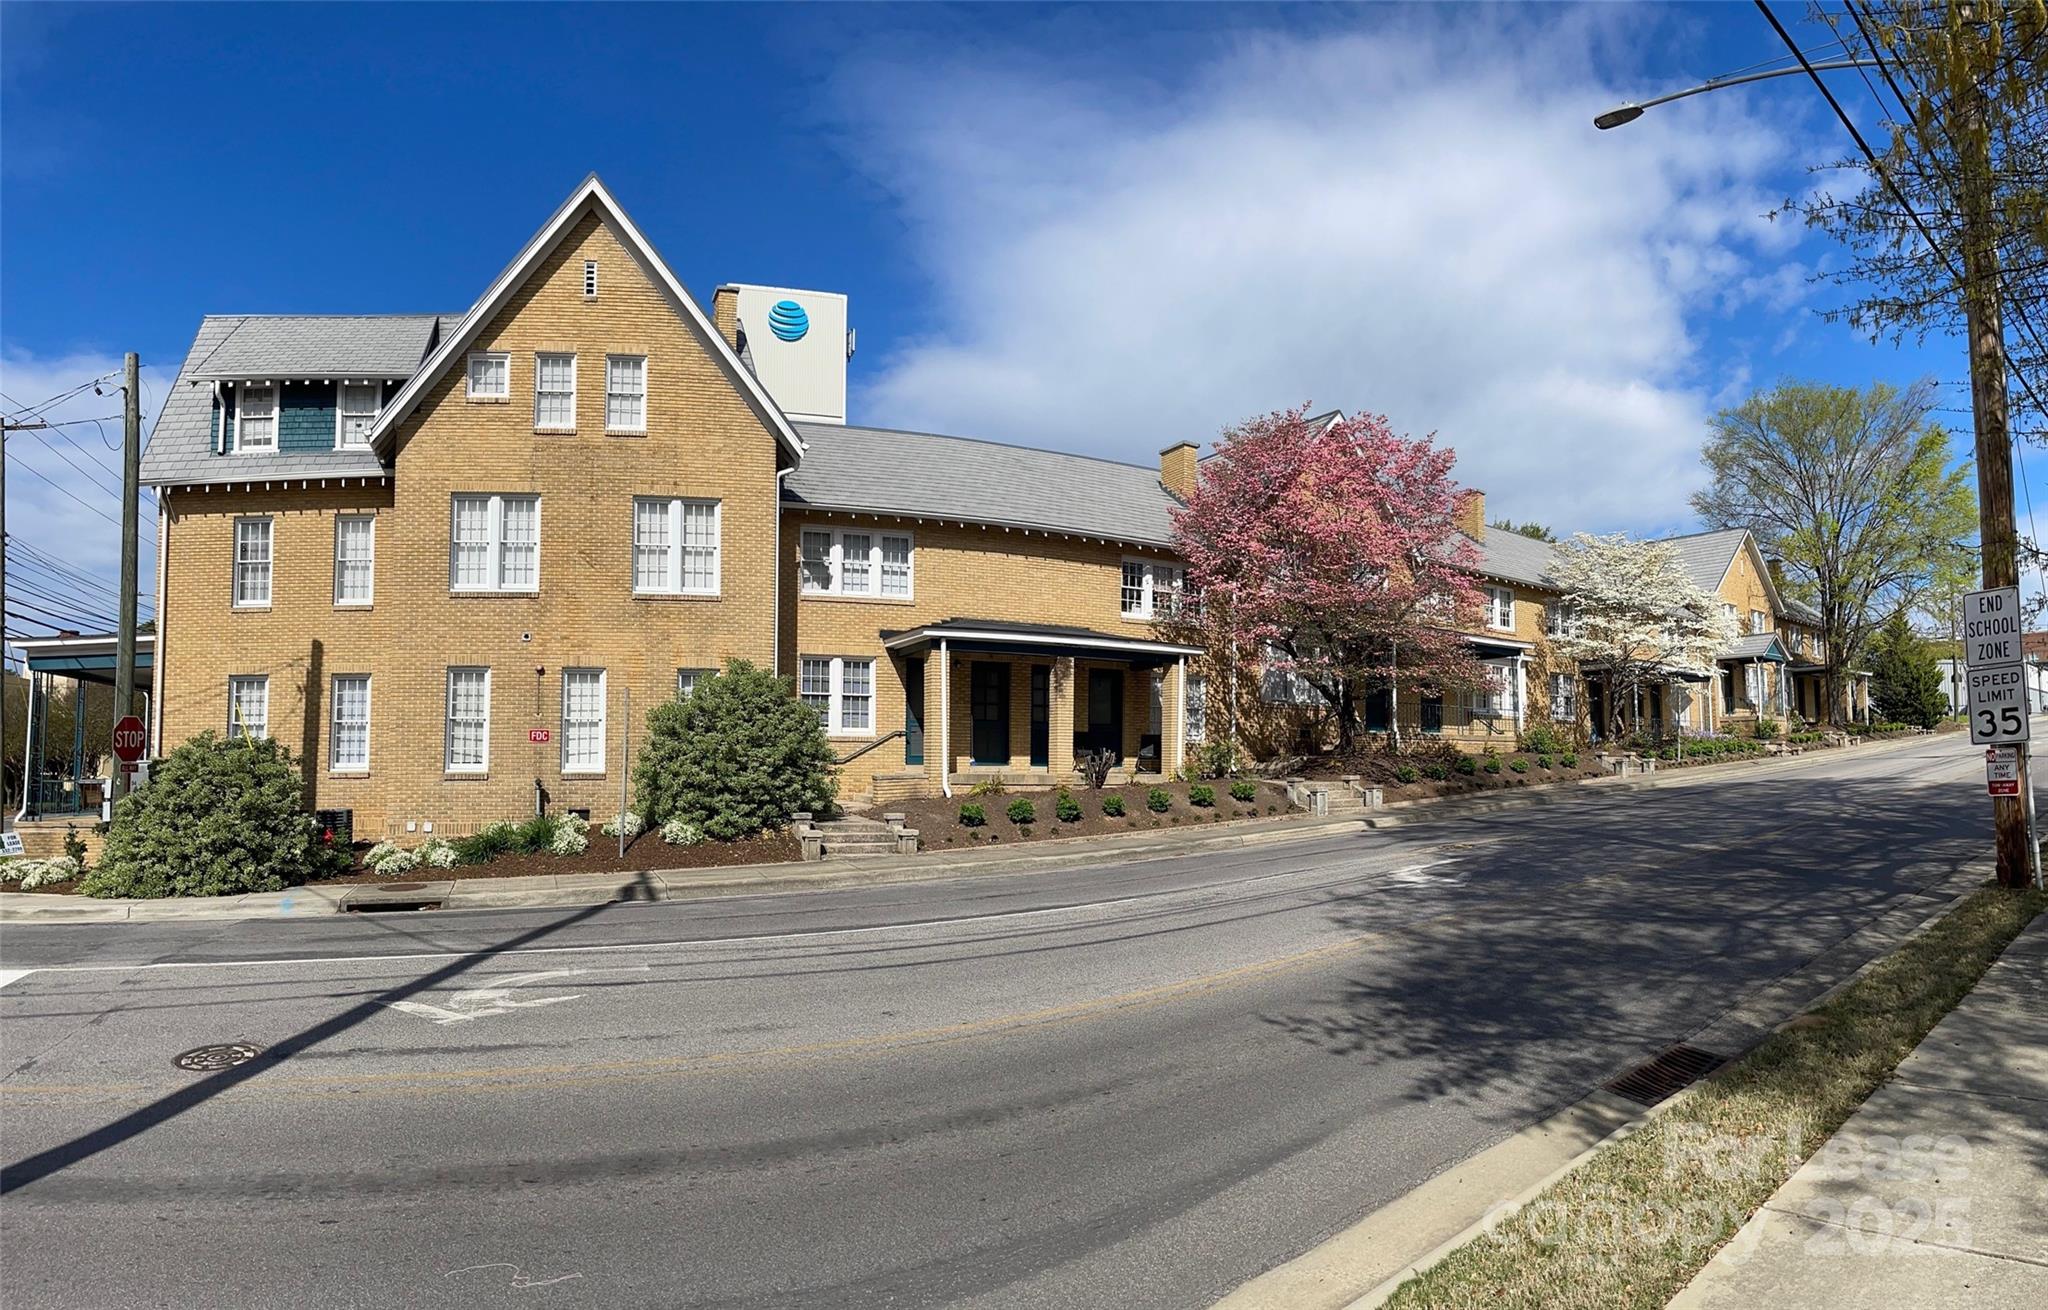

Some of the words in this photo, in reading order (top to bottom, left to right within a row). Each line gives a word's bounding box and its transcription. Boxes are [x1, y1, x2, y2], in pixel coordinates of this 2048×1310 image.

[1979, 594, 2002, 614] END
[1968, 616, 2017, 638] SCHOOL
[1978, 640, 2010, 660] ZONE
[1972, 672, 2020, 688] SPEED
[1977, 689, 2015, 703] LIMIT
[1977, 706, 2022, 738] 35
[115, 731, 144, 748] STOP
[532, 732, 548, 740] FDC
[1986, 752, 1996, 762] NO
